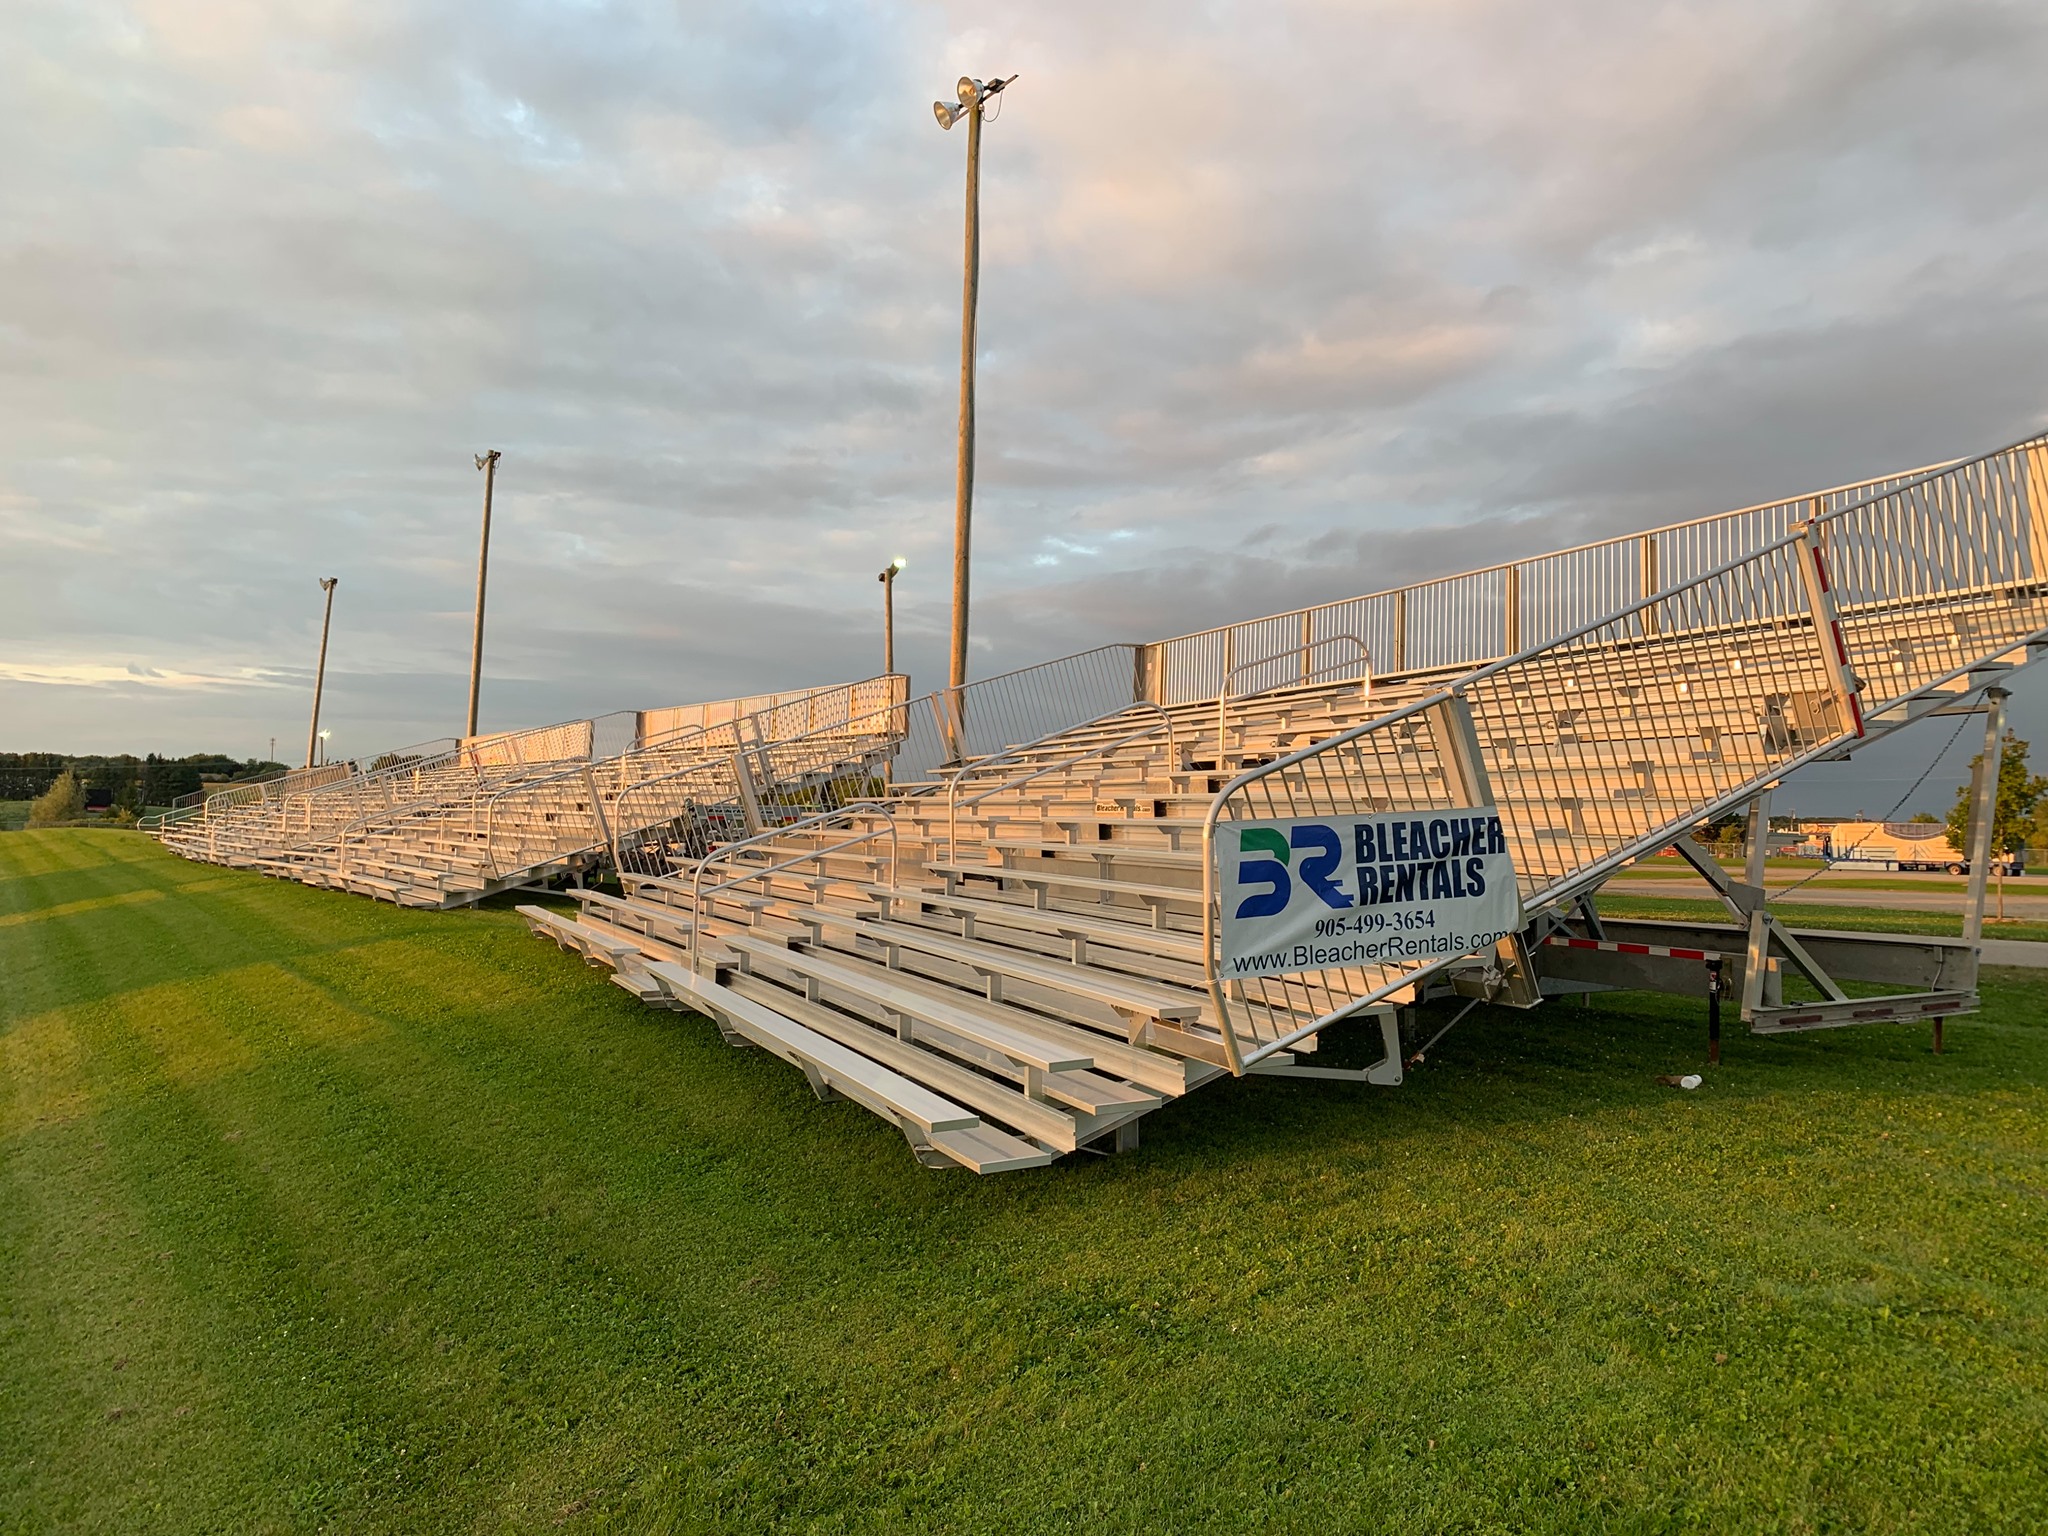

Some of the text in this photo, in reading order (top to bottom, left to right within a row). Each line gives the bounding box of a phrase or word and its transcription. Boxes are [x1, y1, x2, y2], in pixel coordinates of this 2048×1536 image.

[1354, 816, 1506, 864] BLEACHER
[1356, 857, 1486, 907] RENTALS
[1314, 909, 1436, 938] 905-499-3654
[1232, 930, 1508, 973] www.BleacherRentals.com
